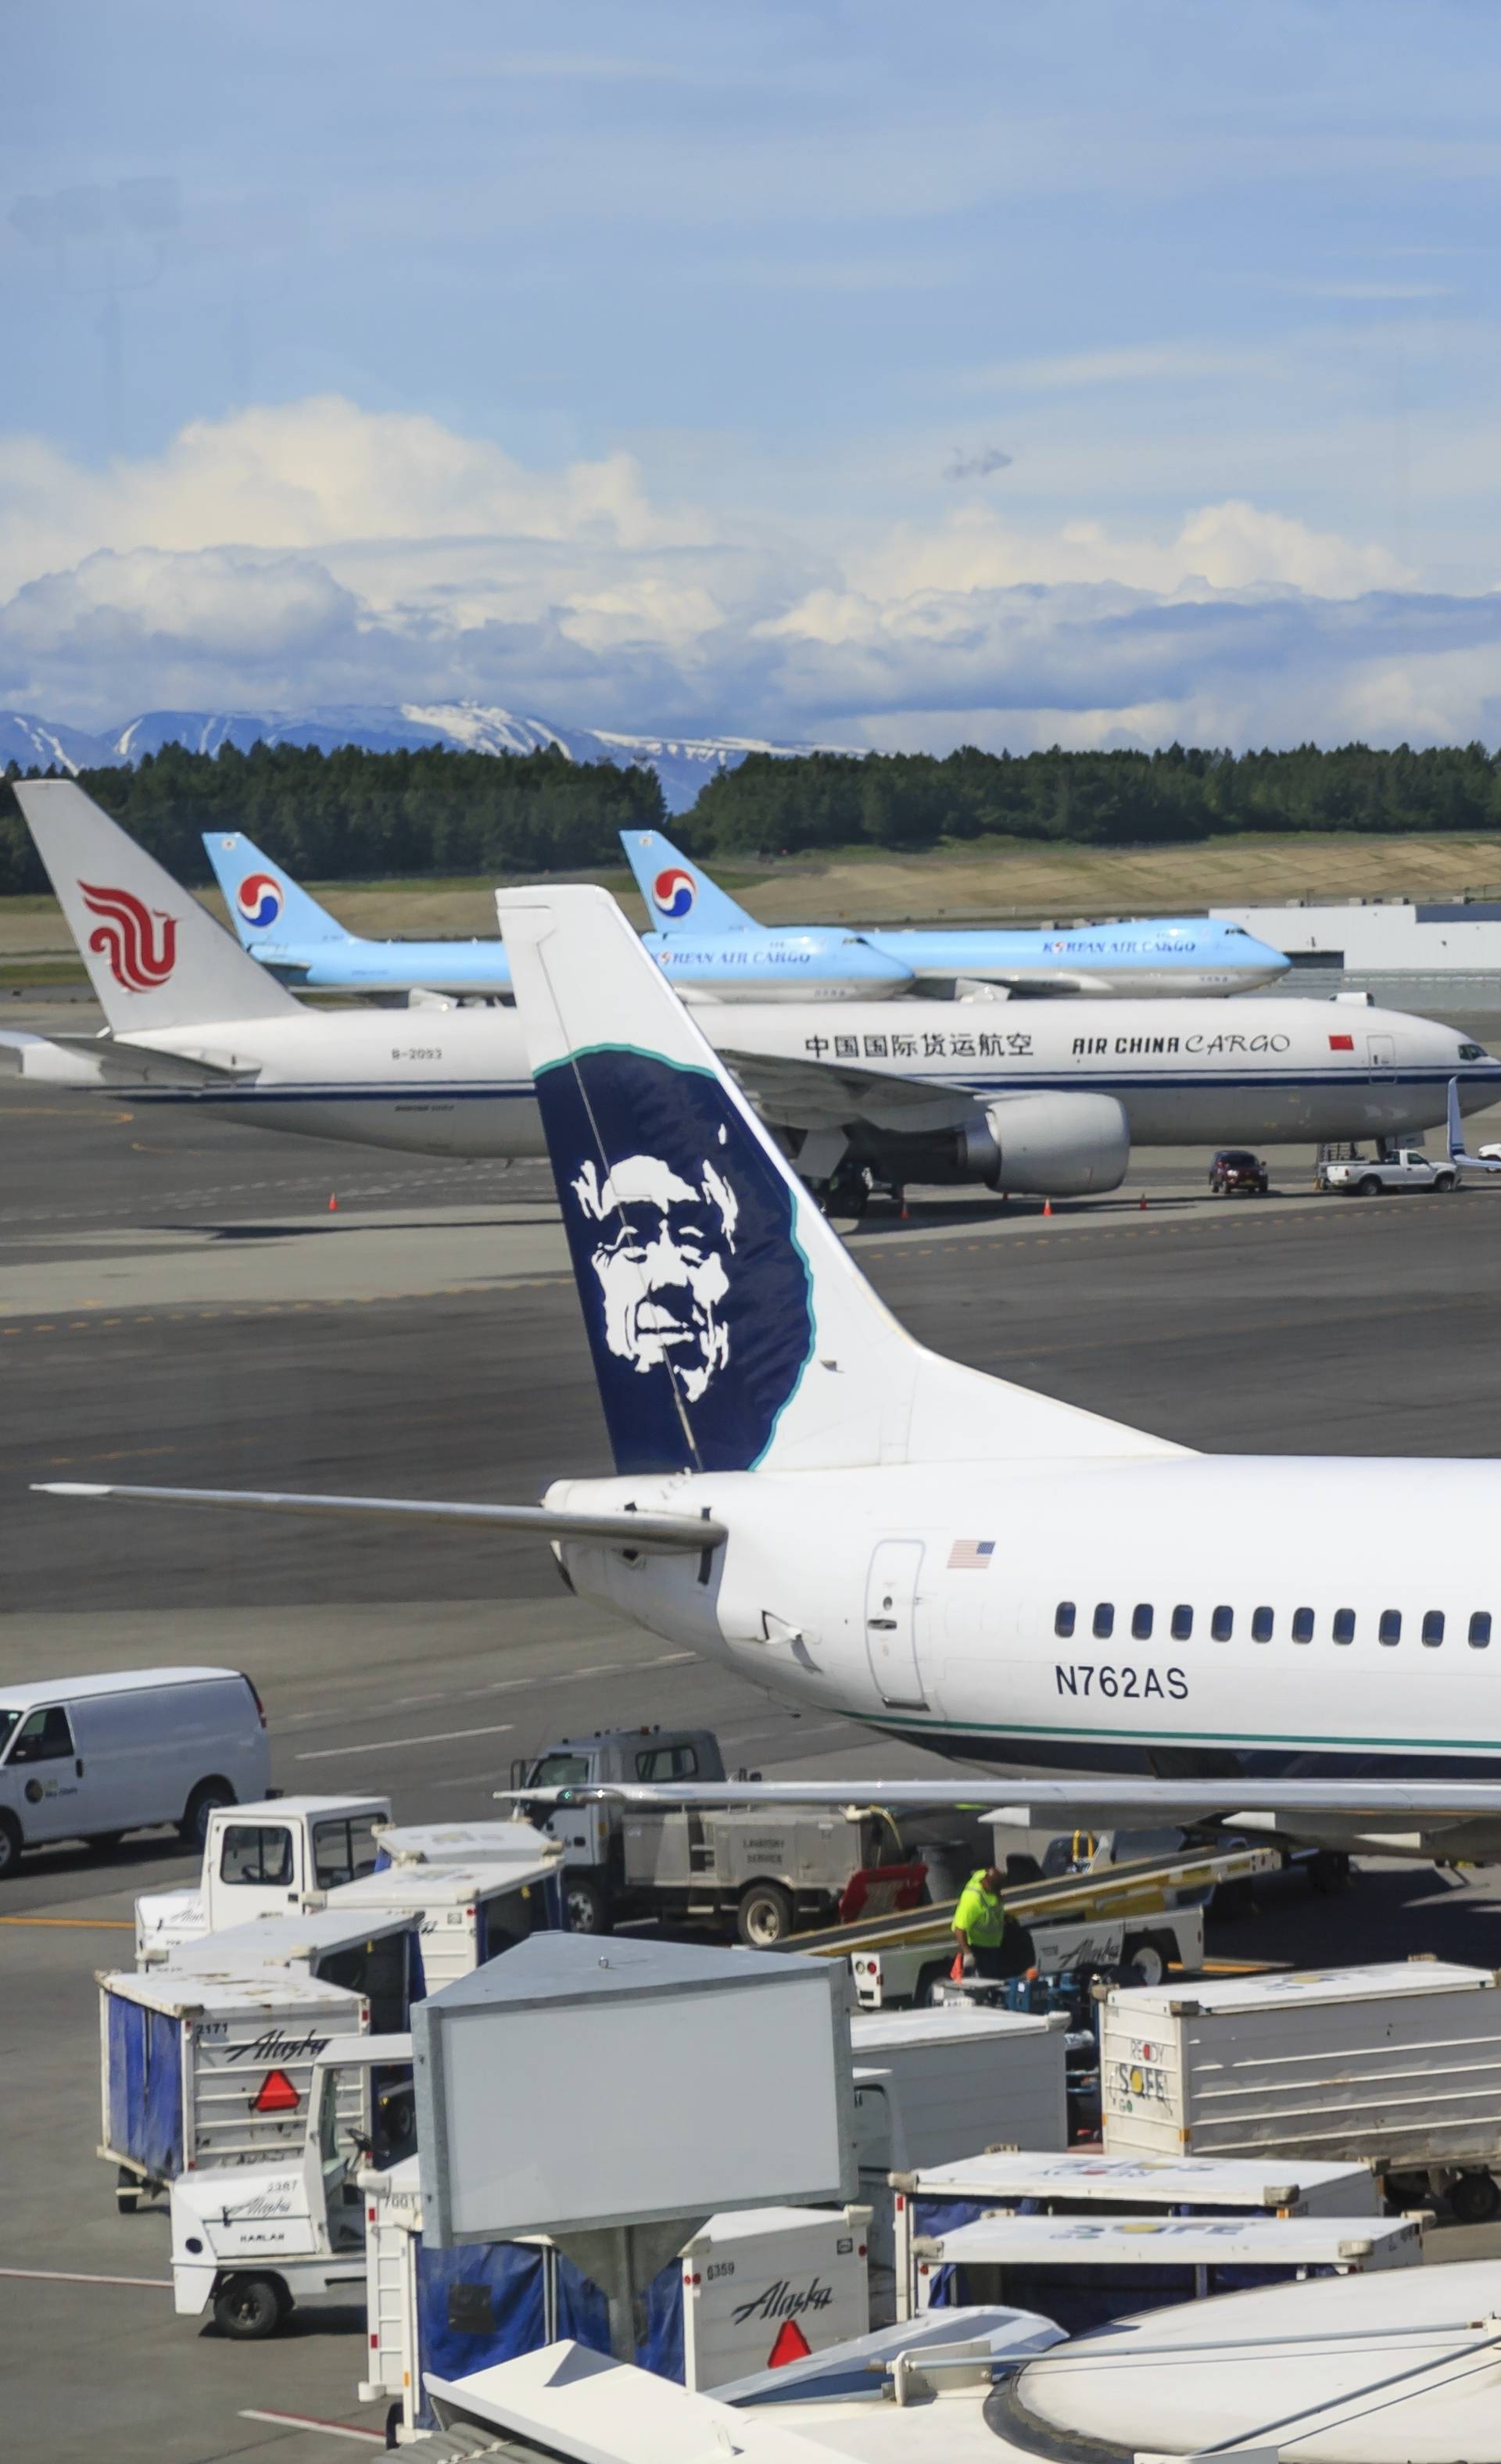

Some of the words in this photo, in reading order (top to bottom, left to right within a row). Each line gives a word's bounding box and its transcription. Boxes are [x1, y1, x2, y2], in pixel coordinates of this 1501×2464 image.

[717, 952, 747, 963] AIR
[752, 951, 811, 963] CARGO
[1108, 942, 1137, 952] AIR
[1141, 942, 1196, 952] CARGO
[804, 1033, 1034, 1058] 中国国际货运航空
[1073, 1038, 1107, 1055] AIR
[1114, 1037, 1180, 1054] CHINA
[1185, 1034, 1291, 1055] CARGO
[1055, 1665, 1189, 1699] N762AS
[731, 2277, 833, 2326] Alaska
